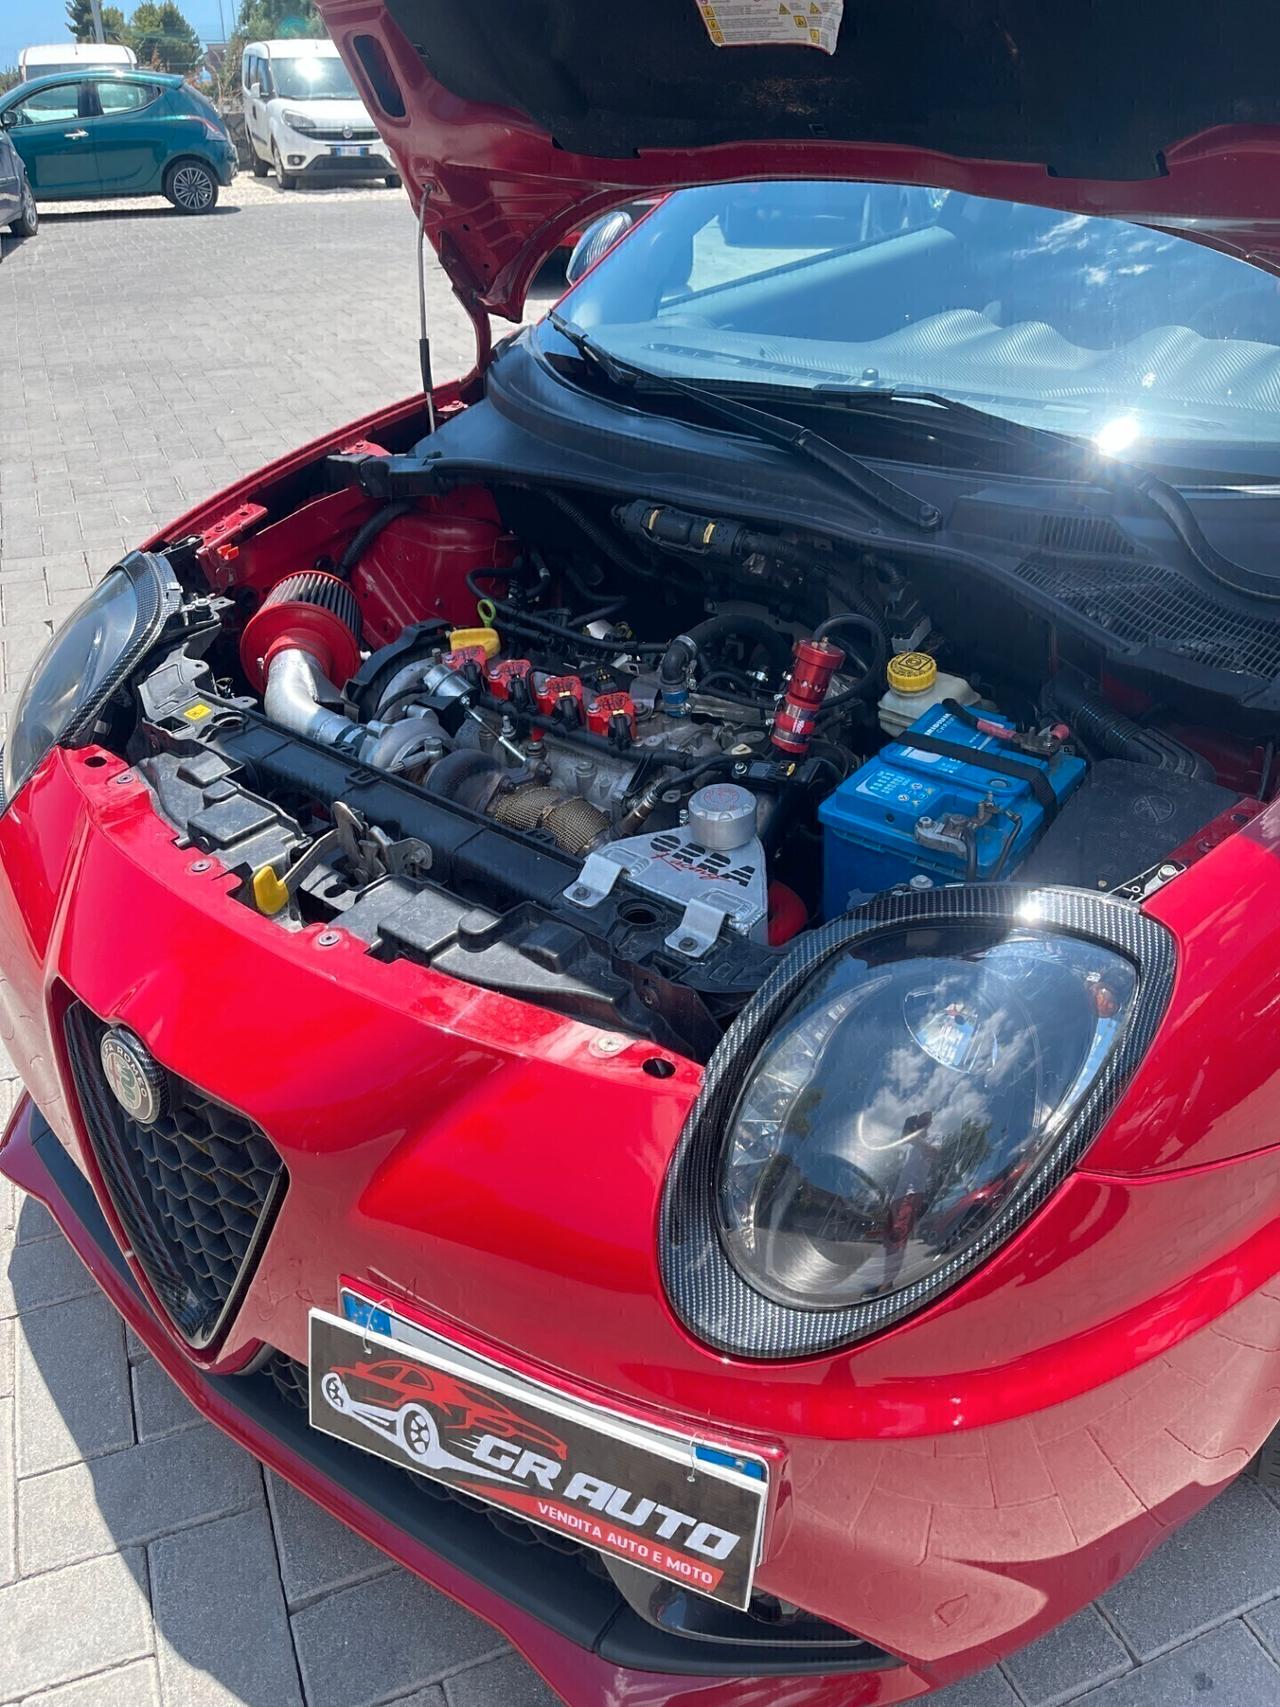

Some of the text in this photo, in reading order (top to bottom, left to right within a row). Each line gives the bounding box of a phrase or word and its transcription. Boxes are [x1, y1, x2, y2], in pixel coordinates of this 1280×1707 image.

[650, 835, 756, 888] ORRA
[116, 1046, 147, 1097] ROMEO
[472, 1434, 741, 1560] GR AUTO
[538, 1502, 713, 1585] VENDITA AUTO E MOTO
